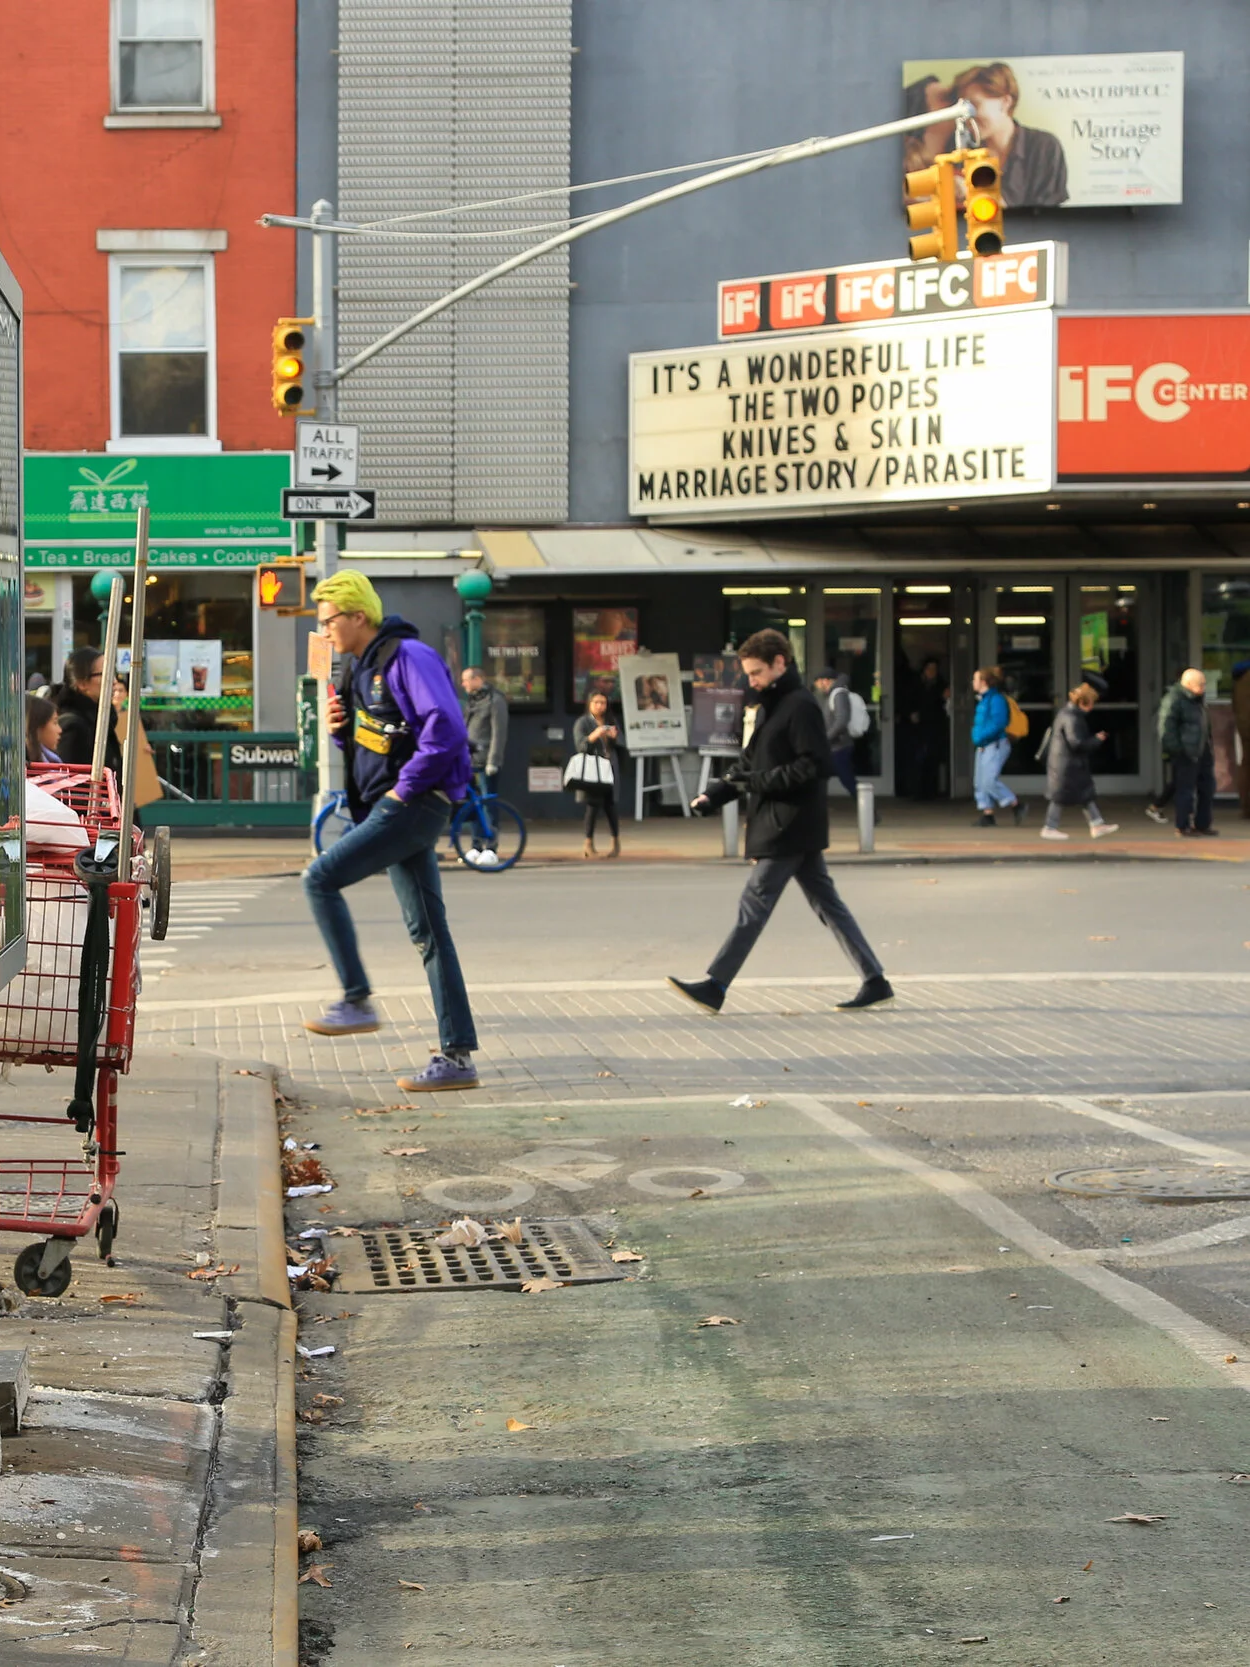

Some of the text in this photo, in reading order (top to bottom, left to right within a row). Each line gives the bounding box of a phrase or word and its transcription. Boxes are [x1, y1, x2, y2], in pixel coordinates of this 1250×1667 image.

[1071, 118, 1162, 143] Marriage
[1091, 142, 1143, 162] Story
[653, 334, 985, 394] IT'S A WONDERFUL LIFE
[729, 376, 938, 422] THE TWO POPES
[312, 428, 345, 444] ALL
[723, 414, 941, 460] KNIVES & SKIN
[302, 446, 354, 460] TRAFFIC
[639, 465, 767, 501] MARRIAGE
[775, 457, 857, 493] STORY
[295, 497, 362, 510] ONE WAY
[38, 548, 278, 565] Tea Bread Cakes Cookies
[230, 745, 299, 766] Subway
